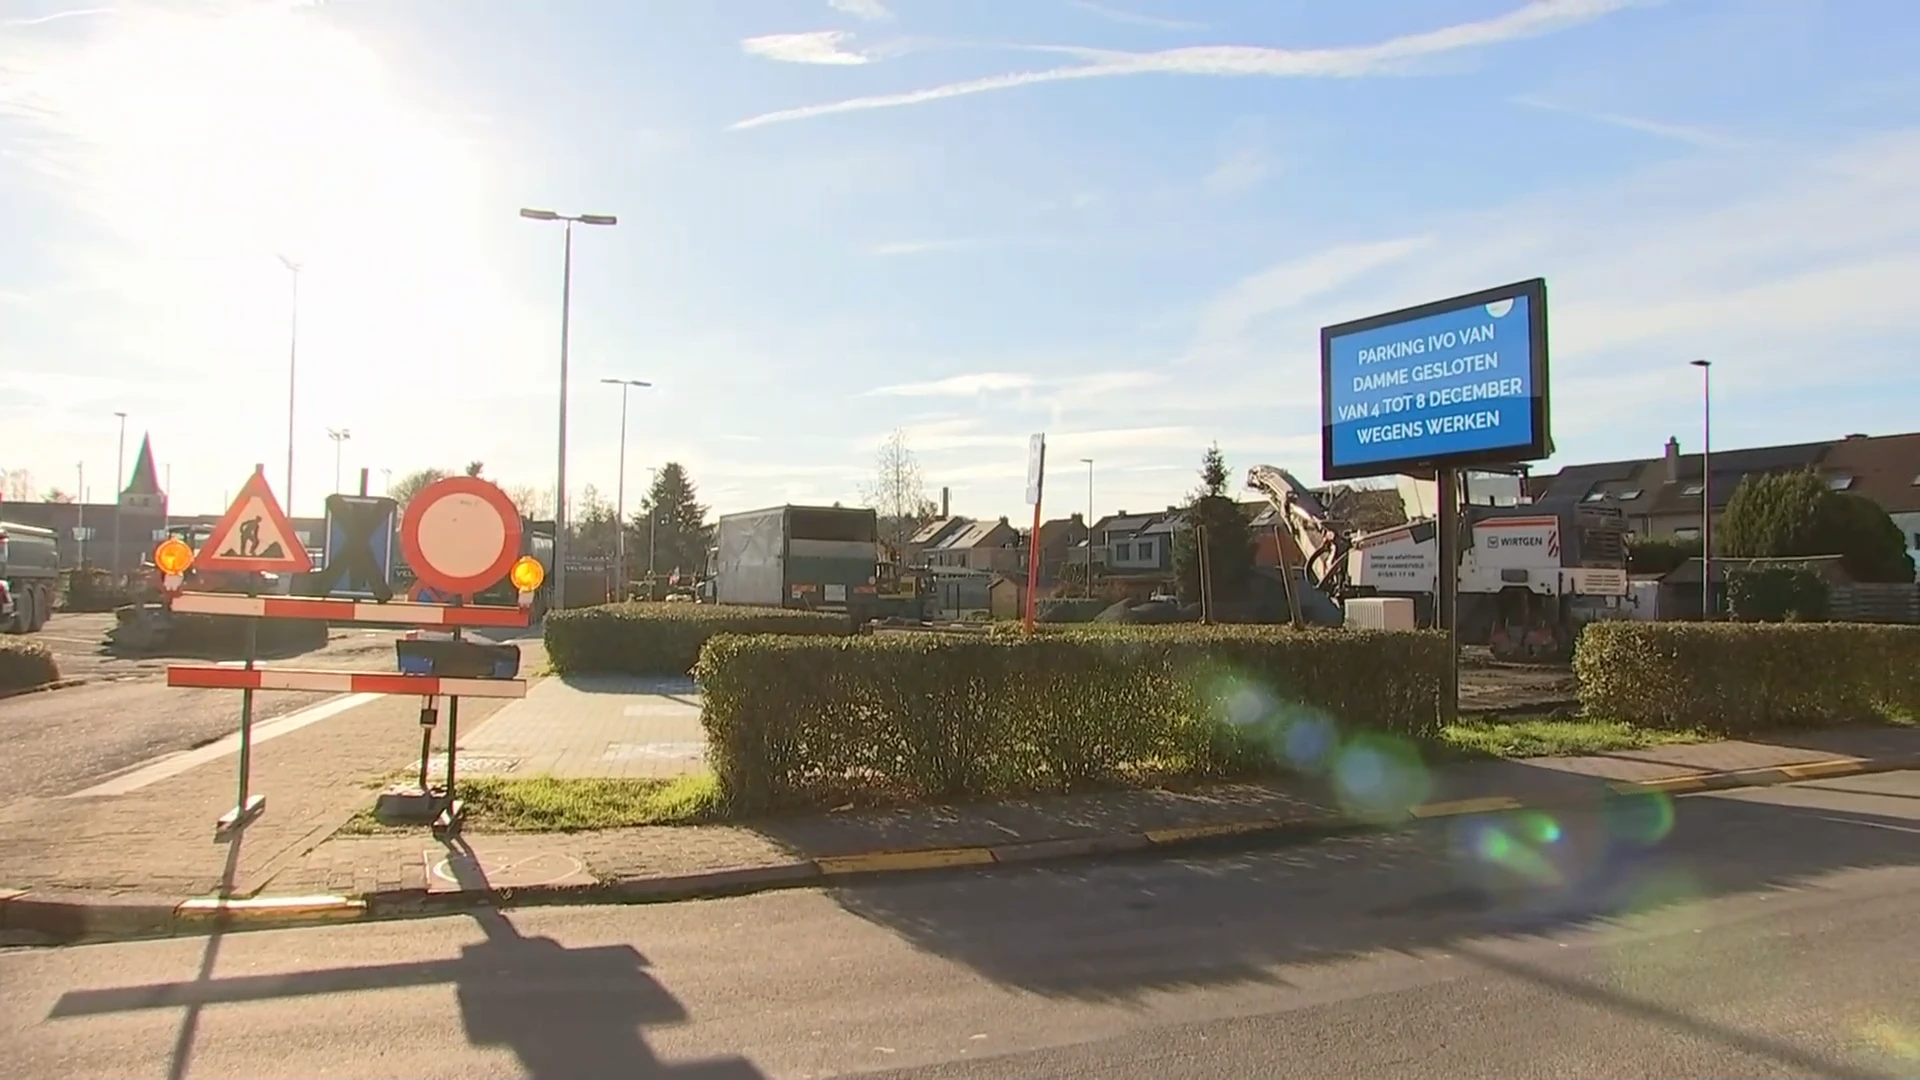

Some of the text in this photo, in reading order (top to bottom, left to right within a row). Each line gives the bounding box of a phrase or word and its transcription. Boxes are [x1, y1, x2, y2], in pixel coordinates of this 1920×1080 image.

[1358, 324, 1495, 365] PARKING IVO VAN
[1353, 352, 1498, 392] DAMME GESLOTEN
[1338, 377, 1522, 421] VAN 4 TOT 8 DECEMBER
[1356, 410, 1500, 444] WEGENS WERKEN
[1500, 536, 1543, 547] WIRTGEN
